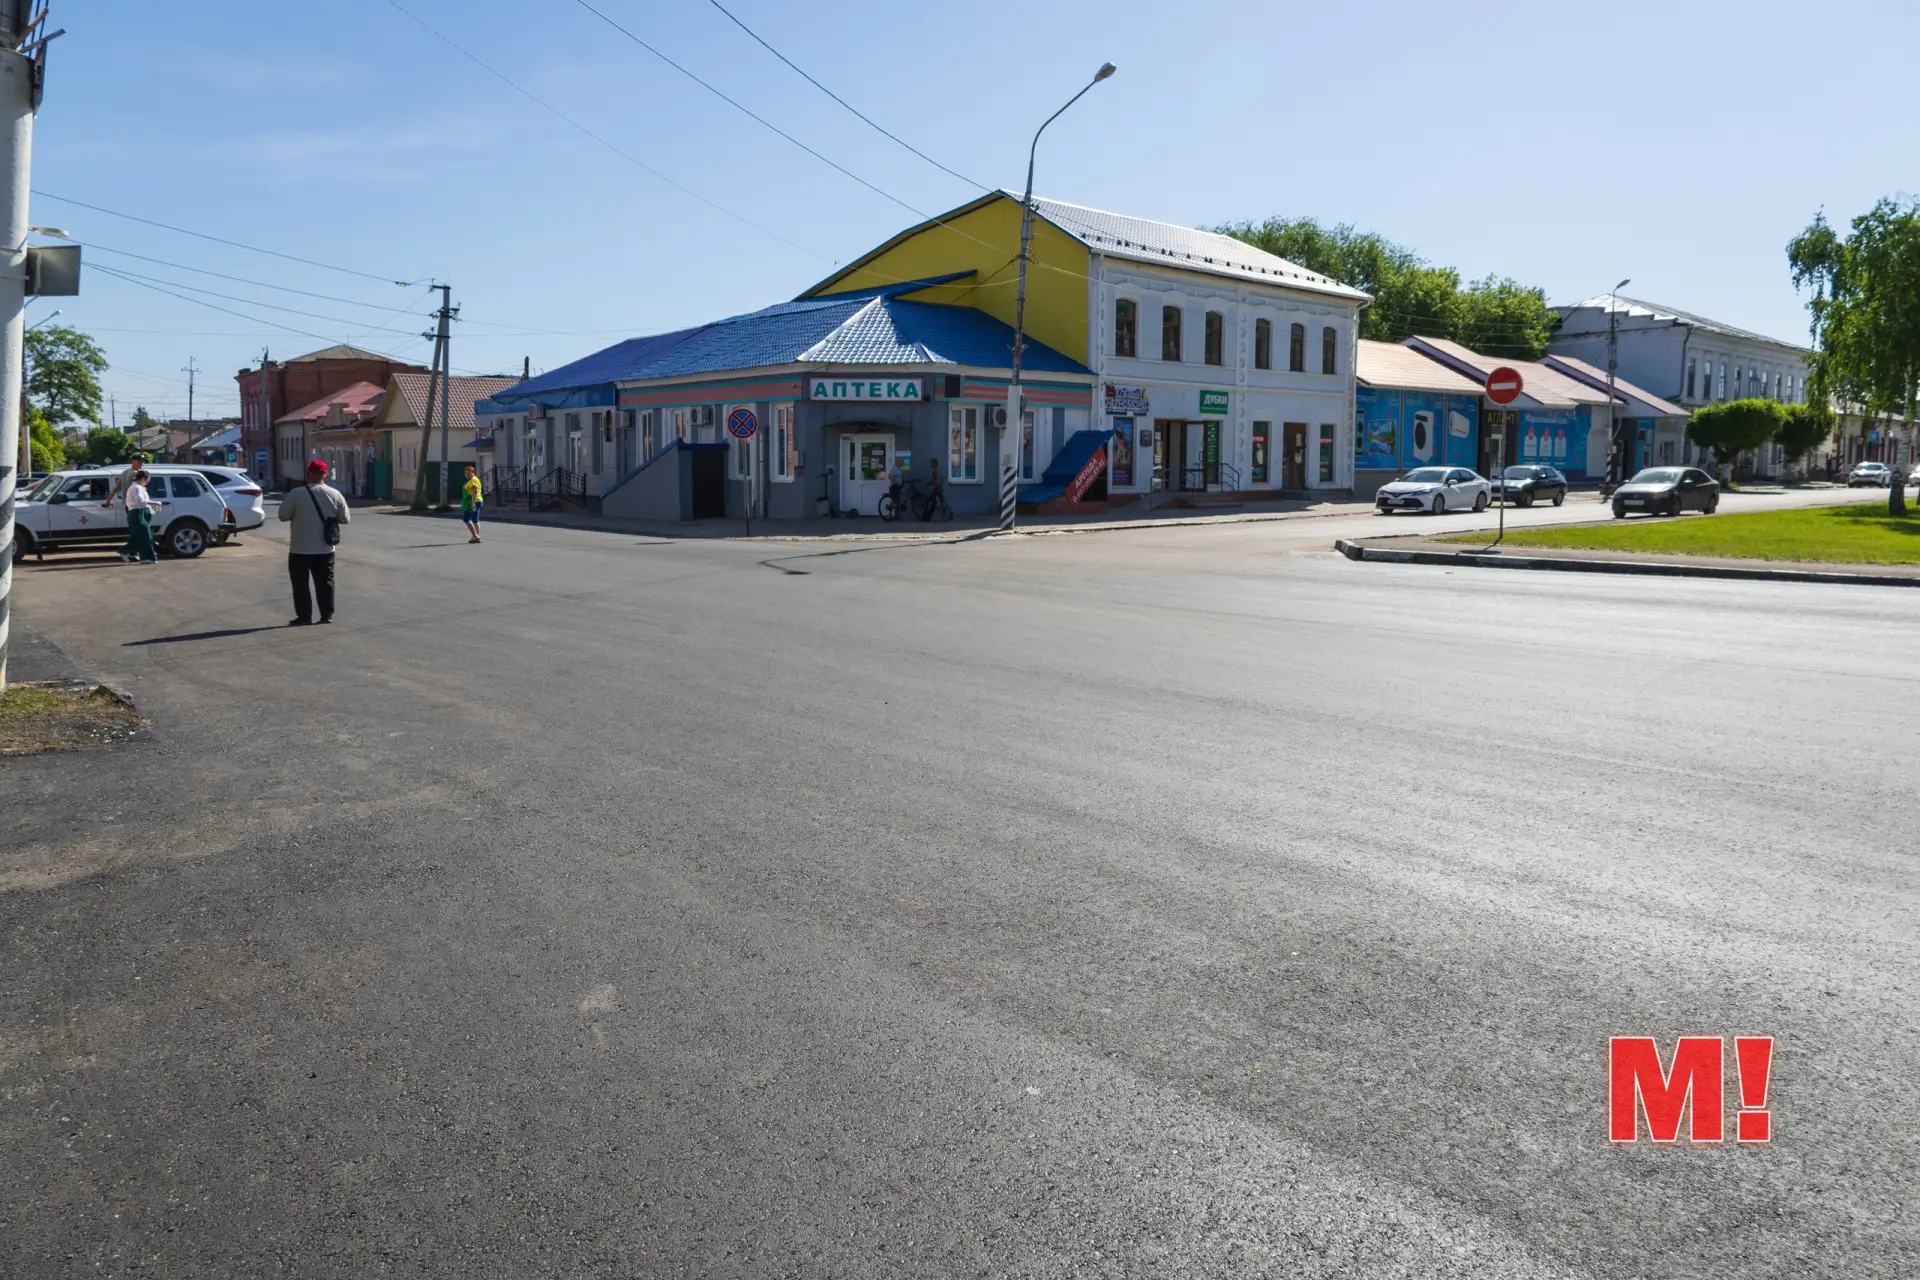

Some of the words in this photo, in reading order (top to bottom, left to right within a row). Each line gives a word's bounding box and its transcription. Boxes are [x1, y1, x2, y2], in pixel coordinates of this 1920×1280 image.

[813, 382, 919, 398] АПТЕКА
[1203, 394, 1228, 406] ДУБКИ
[1487, 412, 1515, 424] АТЛНТ
[1075, 458, 1098, 488] АРЕНДА
